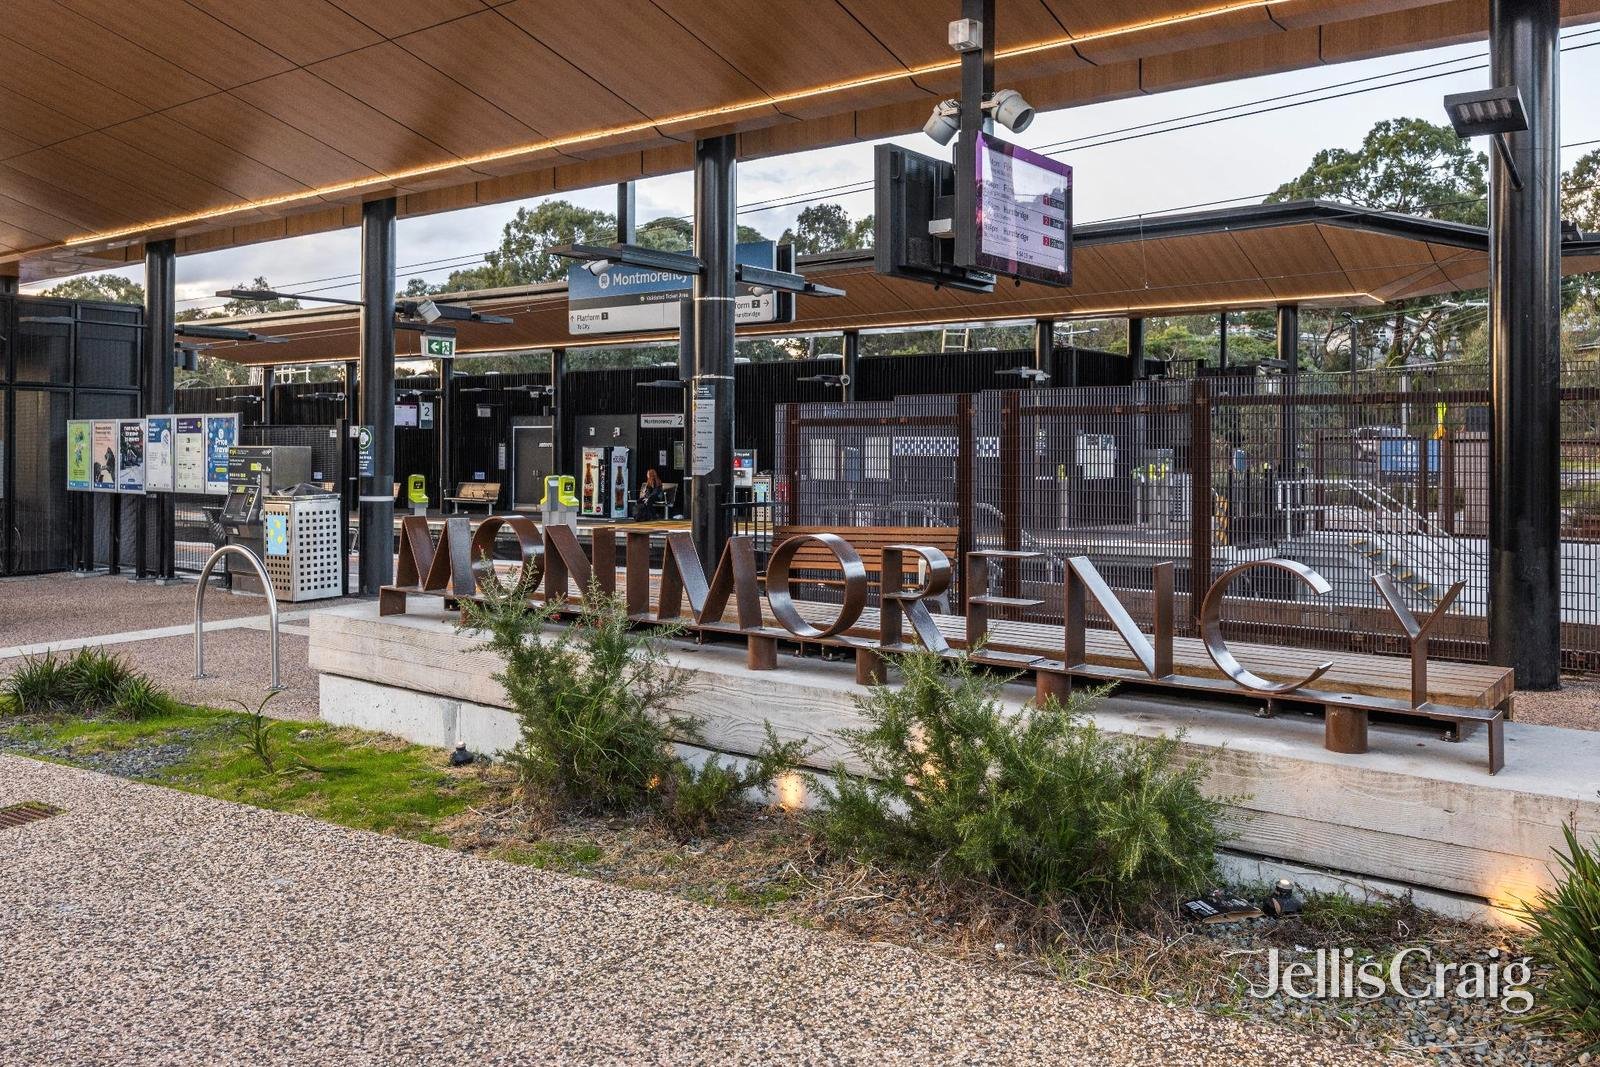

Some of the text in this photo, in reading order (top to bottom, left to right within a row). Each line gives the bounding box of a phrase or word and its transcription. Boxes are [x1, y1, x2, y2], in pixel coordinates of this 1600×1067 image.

[613, 271, 688, 286] Montmorency
[577, 314, 600, 322] Platform
[736, 311, 760, 319] urstbridge
[424, 406, 430, 417] 2
[678, 415, 684, 425] 2
[397, 514, 1468, 709] MONTMORENCY
